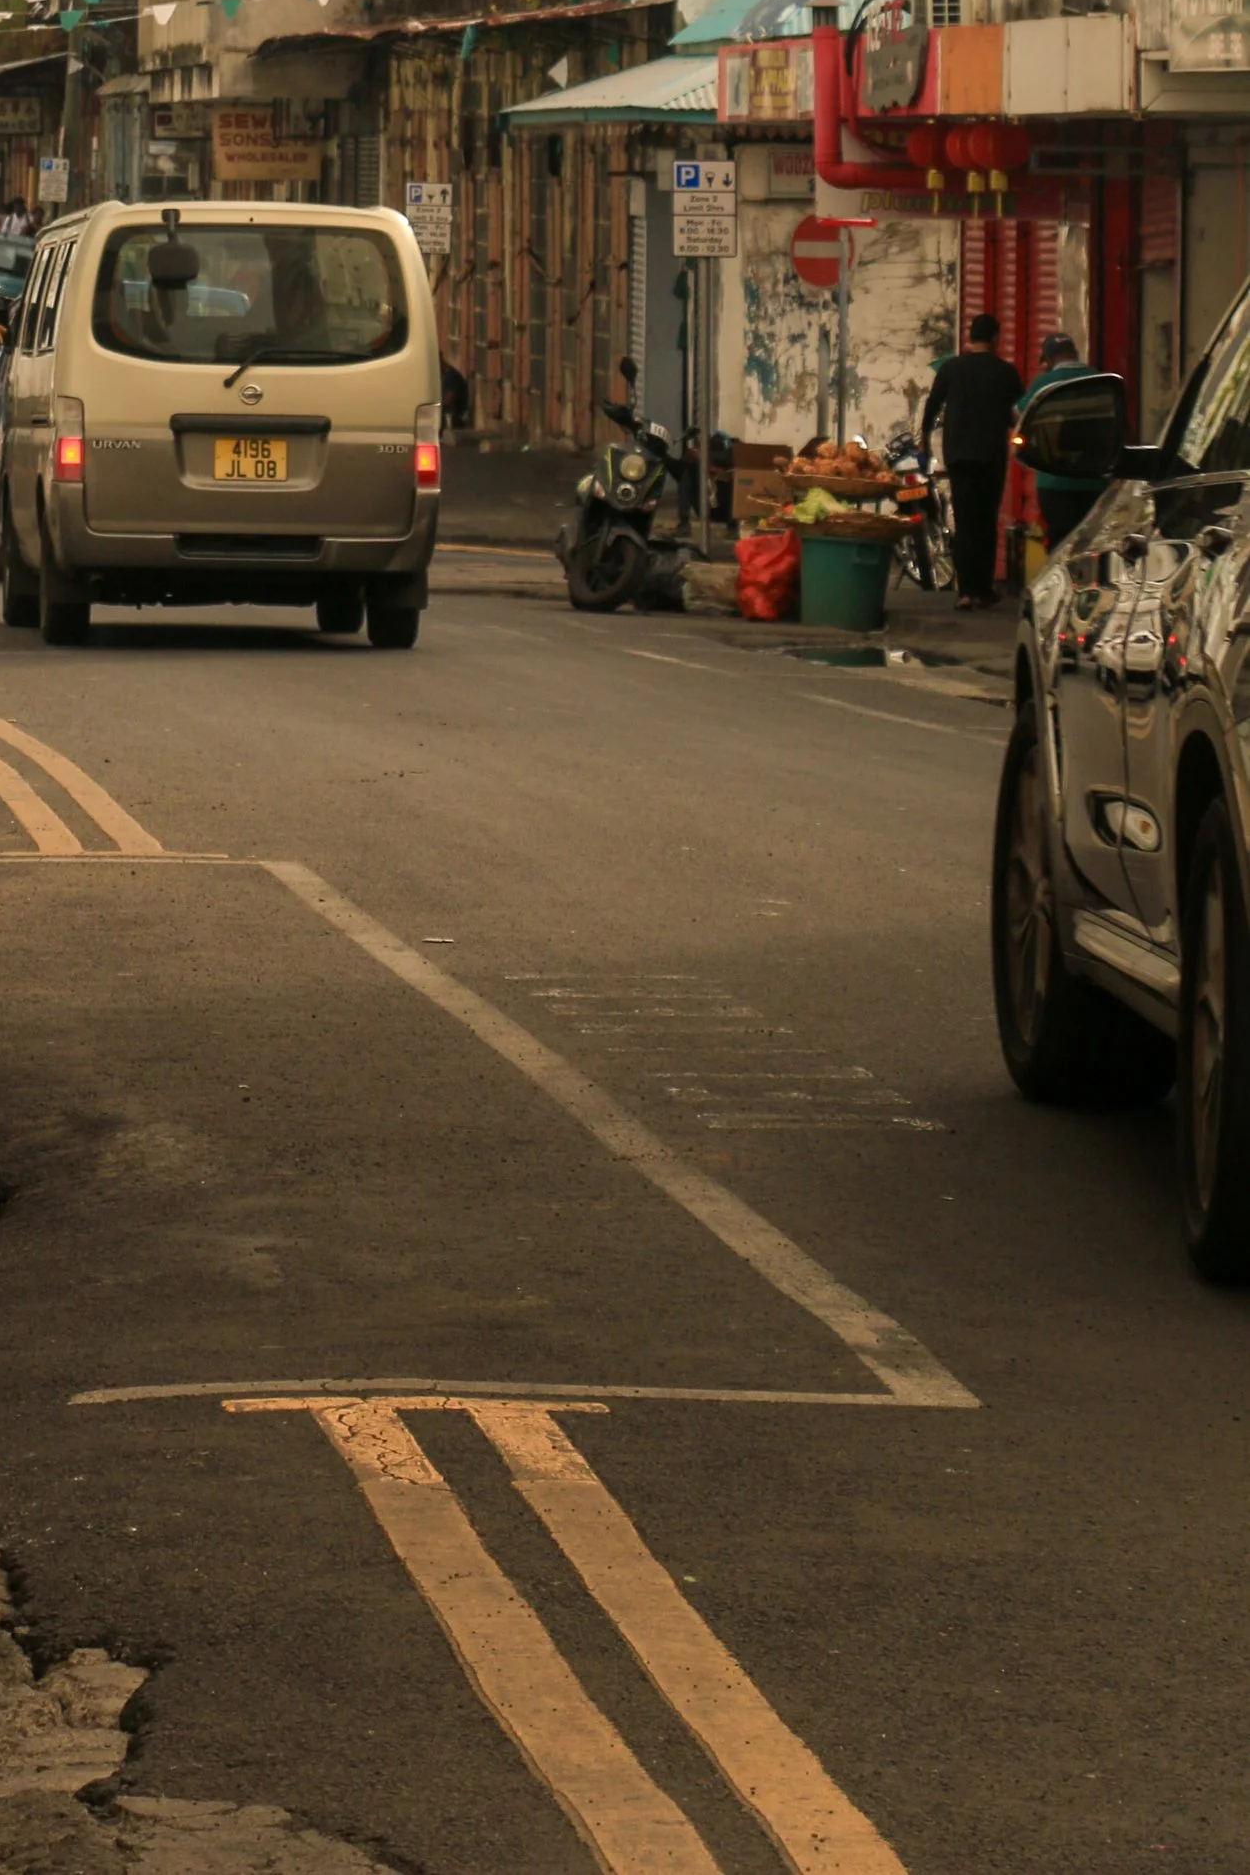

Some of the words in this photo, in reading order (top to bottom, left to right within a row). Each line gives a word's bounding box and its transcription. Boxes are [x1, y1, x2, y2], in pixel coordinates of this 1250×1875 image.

[219, 132, 272, 147] SONS
[92, 440, 142, 449] URVAN
[231, 439, 272, 460] 4196
[225, 460, 247, 479] JL
[254, 460, 277, 479] 08
